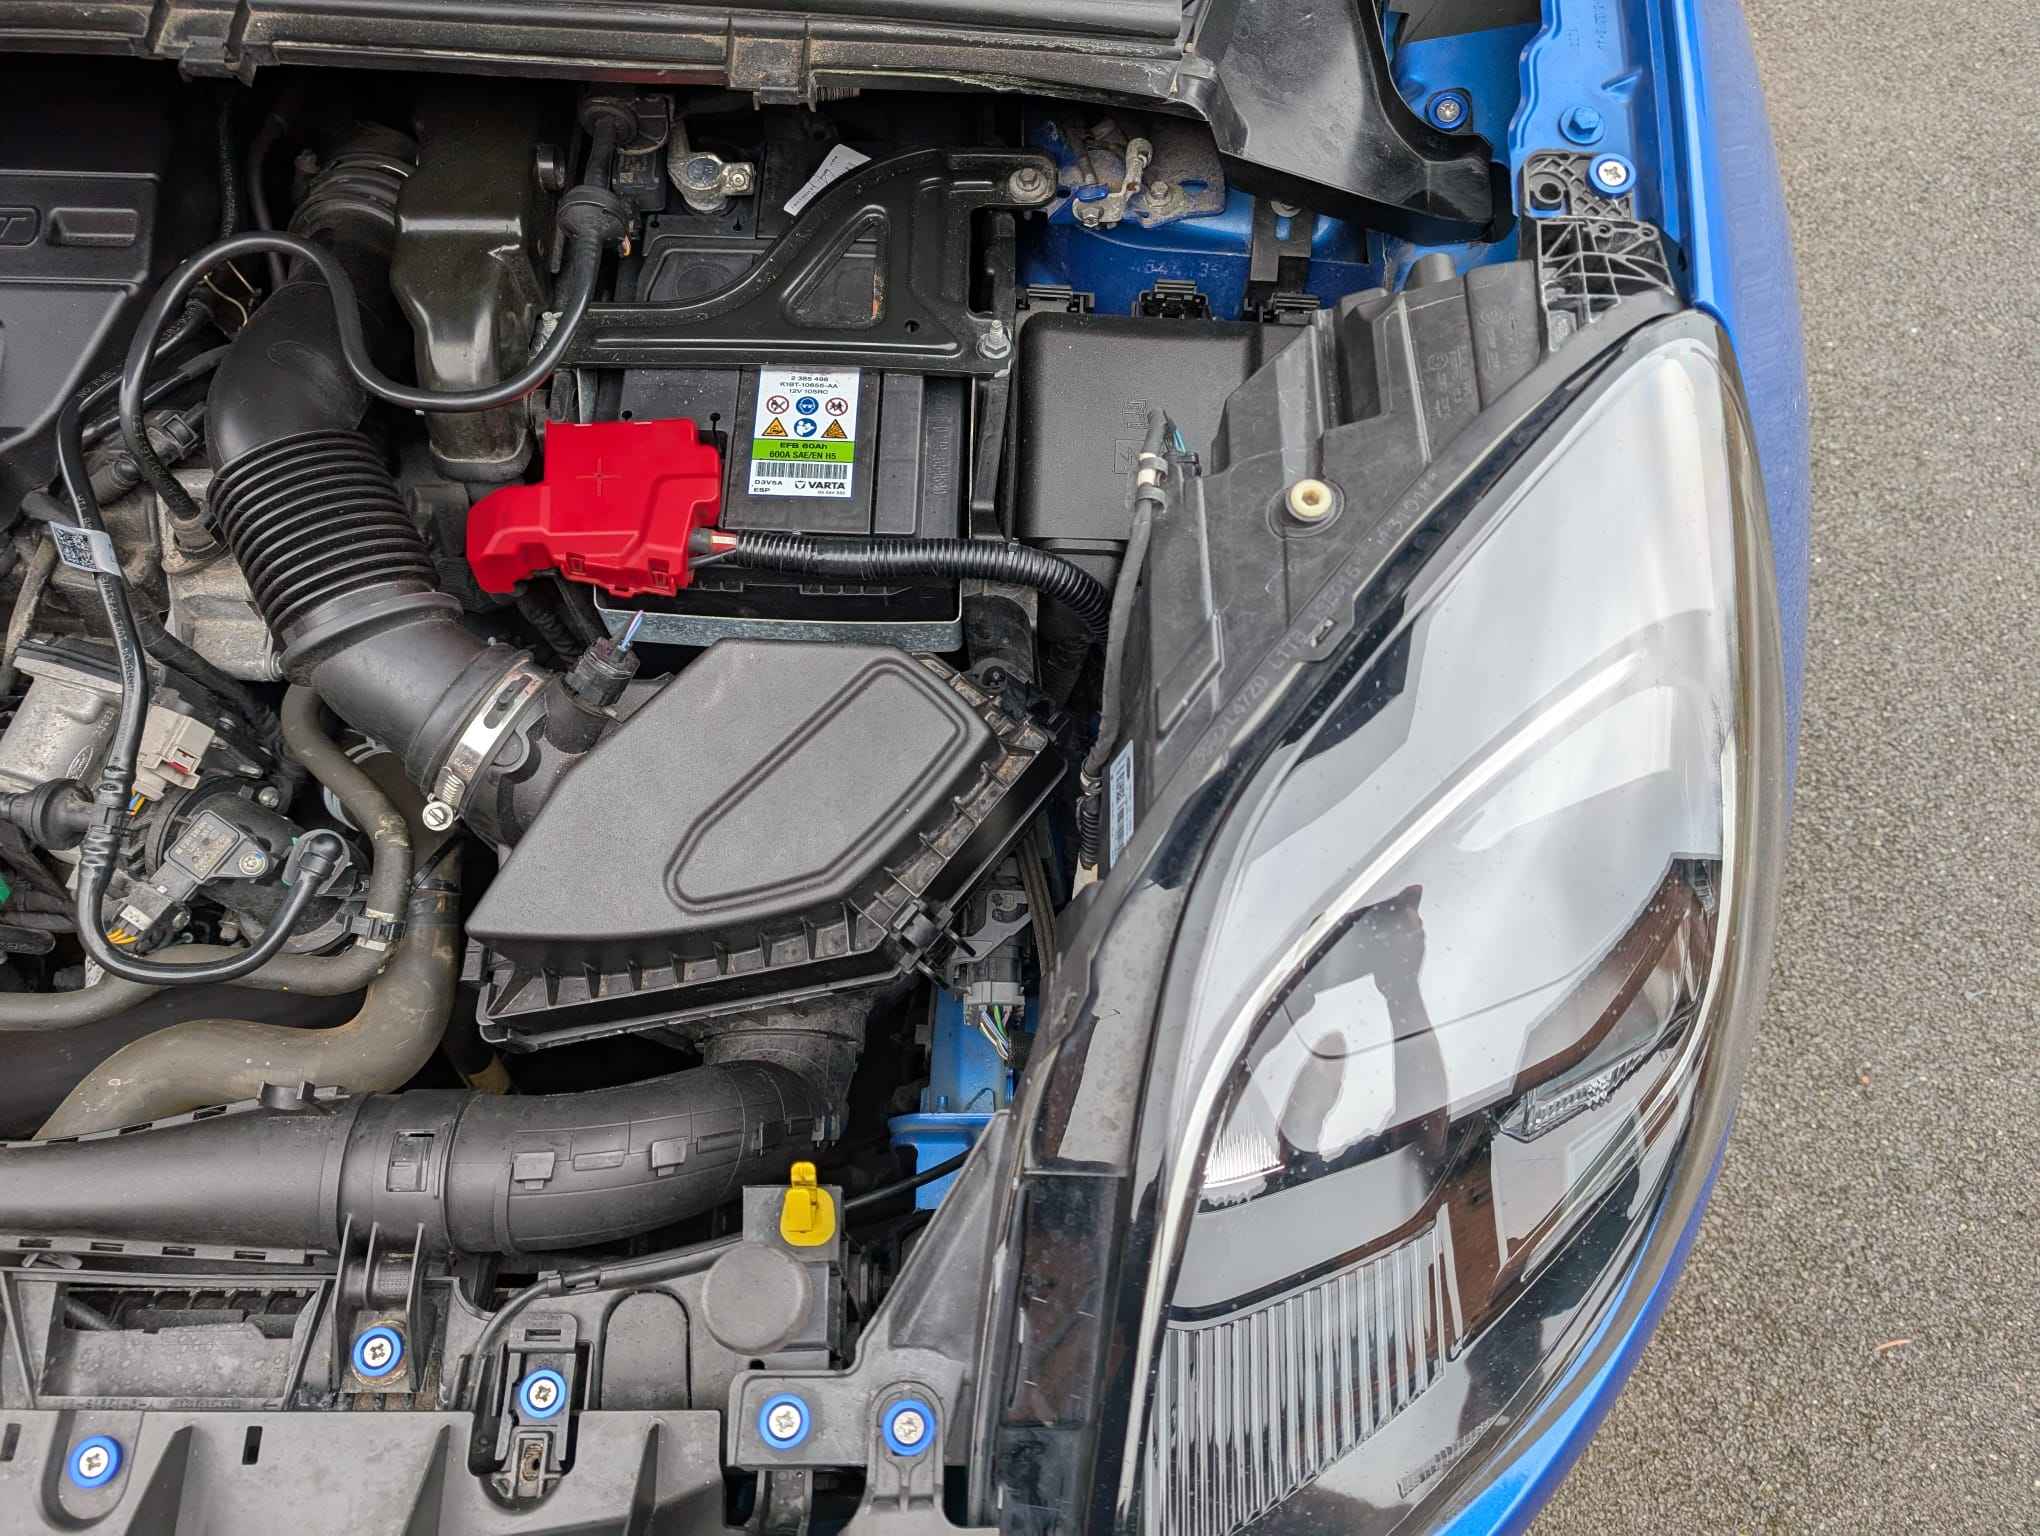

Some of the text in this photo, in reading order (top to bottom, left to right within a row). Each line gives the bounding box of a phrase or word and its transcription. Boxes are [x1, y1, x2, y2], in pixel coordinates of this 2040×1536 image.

[793, 451, 823, 459] SAE/EN
[825, 452, 837, 460] H5
[808, 481, 846, 490] VARTA
